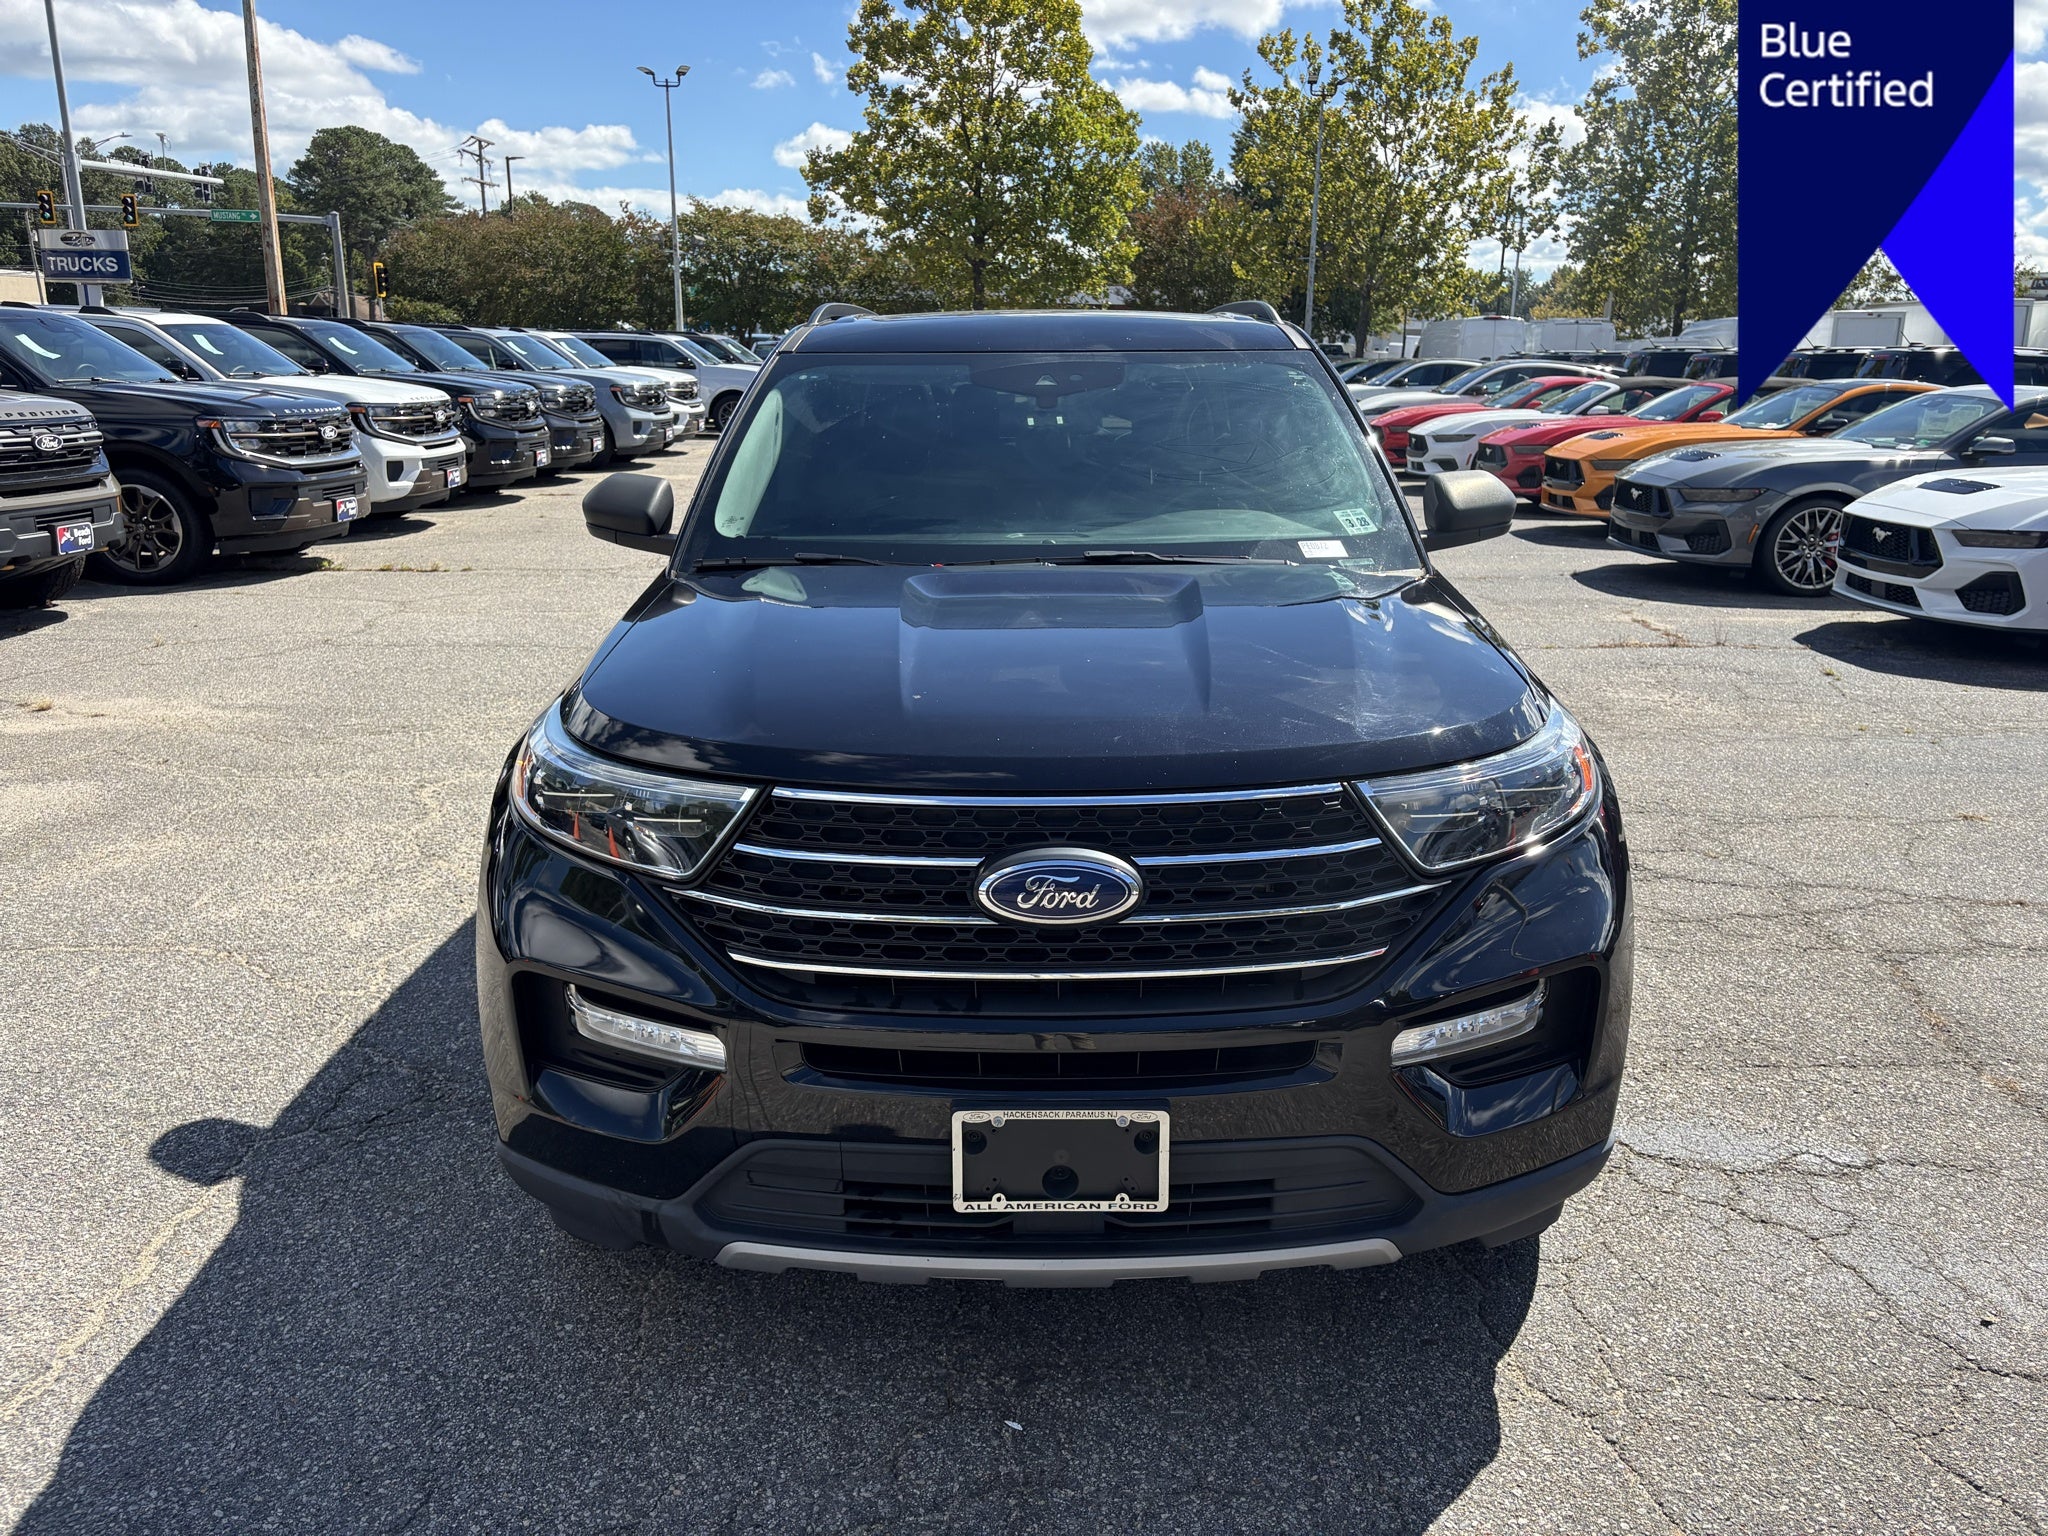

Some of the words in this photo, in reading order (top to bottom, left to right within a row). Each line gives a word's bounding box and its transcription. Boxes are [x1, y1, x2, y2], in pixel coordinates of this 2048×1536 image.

[213, 211, 240, 220] MUSTANG
[46, 256, 119, 272] TRUCKS
[0, 409, 79, 418] PEDITION
[40, 435, 59, 449] Ford
[1345, 518, 1355, 528] 3
[73, 526, 91, 538] Beach
[78, 534, 92, 546] Ford
[1016, 874, 1102, 909] Ford
[1107, 1111, 1118, 1119] NJ
[963, 1203, 998, 1211] ALL
[1003, 1202, 1101, 1211] AMERICAN
[1108, 1202, 1158, 1210] FORD
